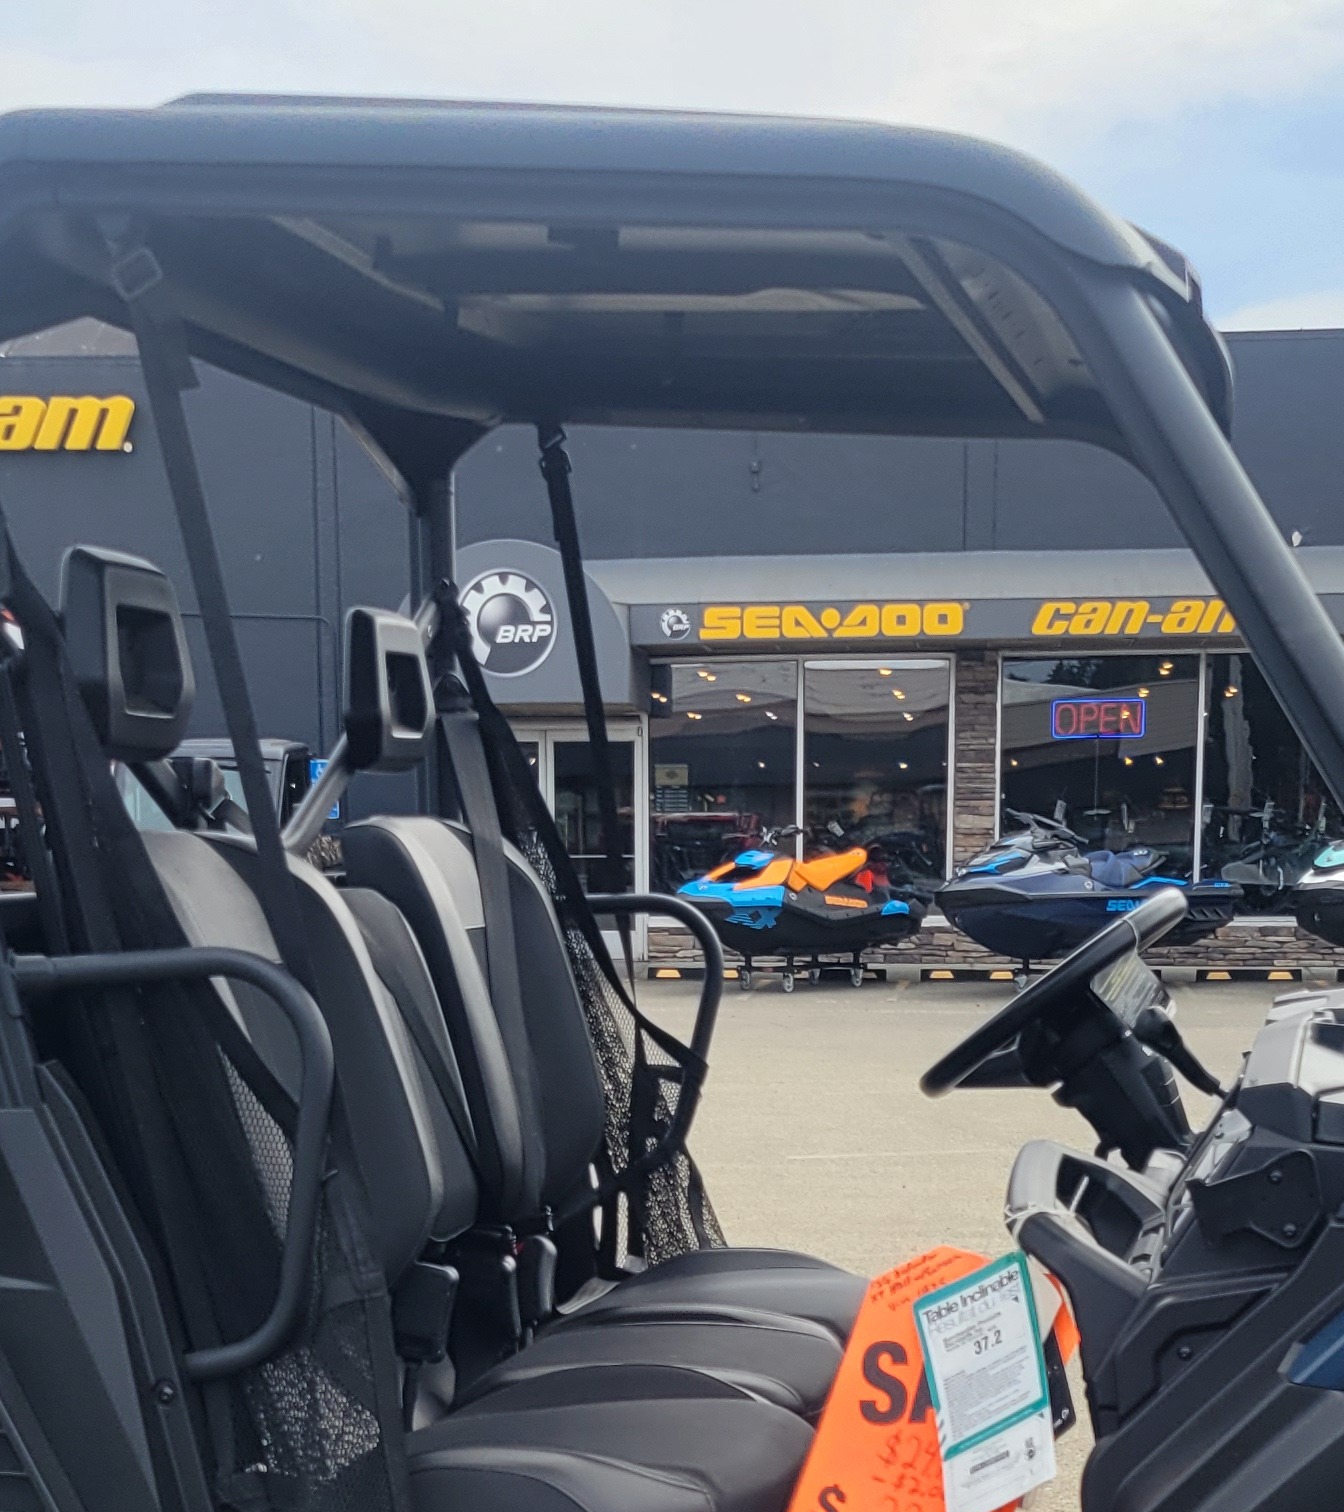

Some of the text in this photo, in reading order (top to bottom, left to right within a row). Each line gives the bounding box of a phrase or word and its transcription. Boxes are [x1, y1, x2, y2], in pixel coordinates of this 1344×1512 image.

[496, 624, 552, 644] BRP
[1055, 703, 1143, 735] OPEN
[973, 1329, 1004, 1356] 37.2
